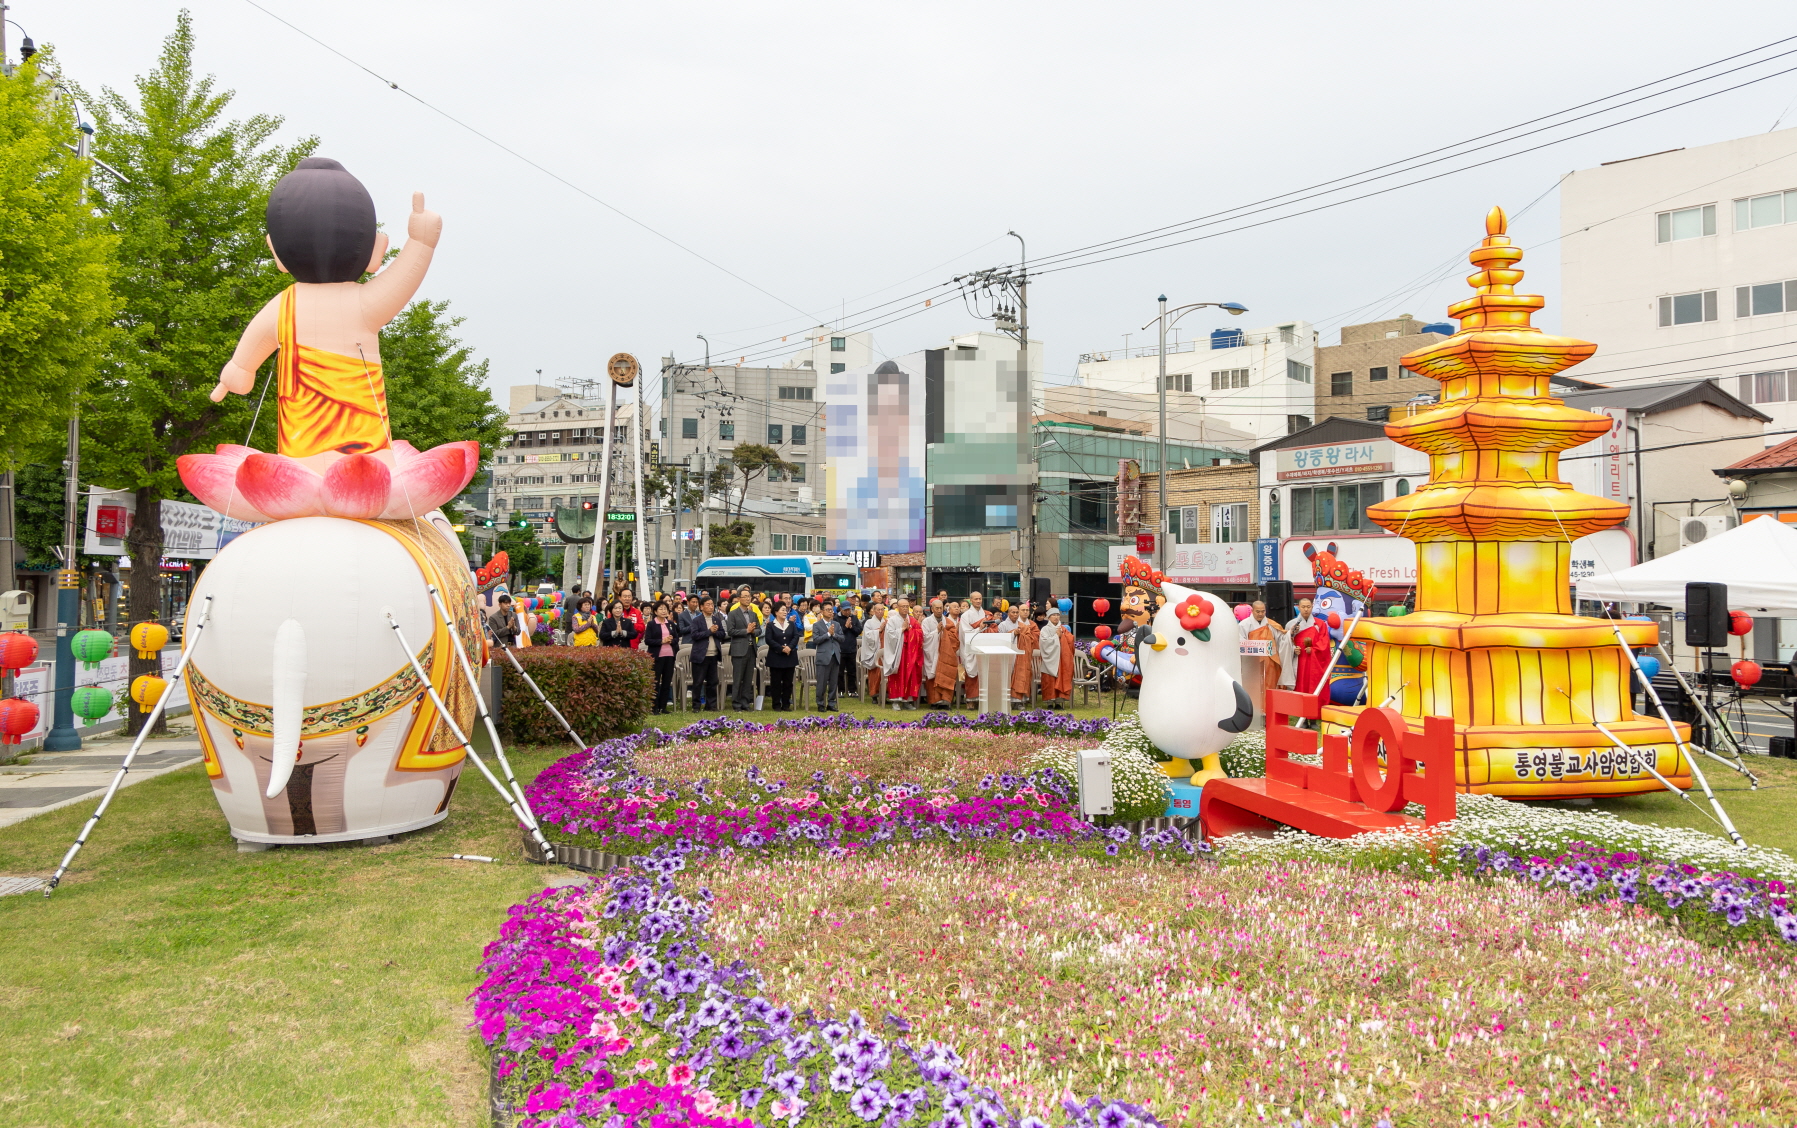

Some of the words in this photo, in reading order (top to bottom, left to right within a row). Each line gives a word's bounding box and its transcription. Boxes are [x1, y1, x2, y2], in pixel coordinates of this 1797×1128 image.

[1294, 447, 1341, 468] 왕중왕
[1345, 445, 1374, 462] 라사
[1609, 444, 1621, 497] 엘리트
[607, 513, 635, 521] 18:32:01
[1186, 510, 1194, 522] 옷
[1262, 544, 1274, 576] 왕중왕
[1571, 559, 1595, 569] 학생복
[1369, 566, 1400, 579] Fresh
[1404, 566, 1417, 579] Lo
[1514, 748, 1657, 778] 통영불교사암연합회
[1173, 798, 1192, 809] 통영
